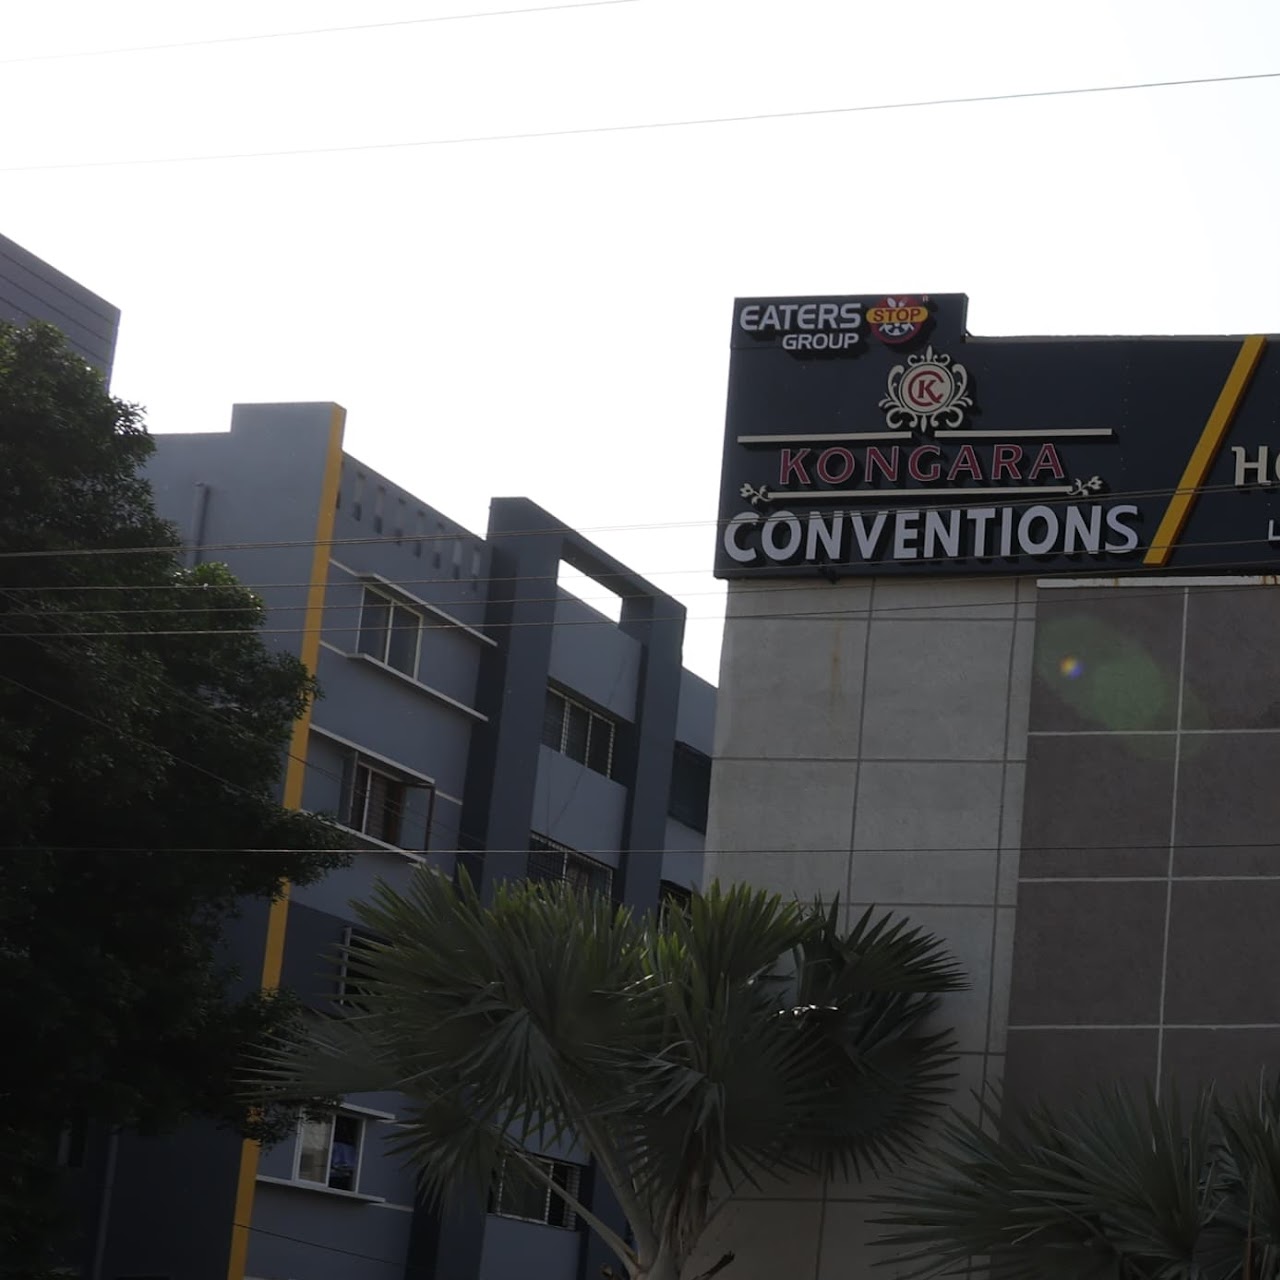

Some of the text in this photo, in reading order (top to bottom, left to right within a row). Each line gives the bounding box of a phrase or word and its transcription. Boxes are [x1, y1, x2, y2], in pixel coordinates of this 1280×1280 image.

[740, 302, 861, 332] EATERS
[873, 308, 921, 322] STOP
[782, 333, 859, 350] GROUP
[779, 443, 1065, 485] KONGARA
[723, 504, 1139, 562] CONVENTIONS
